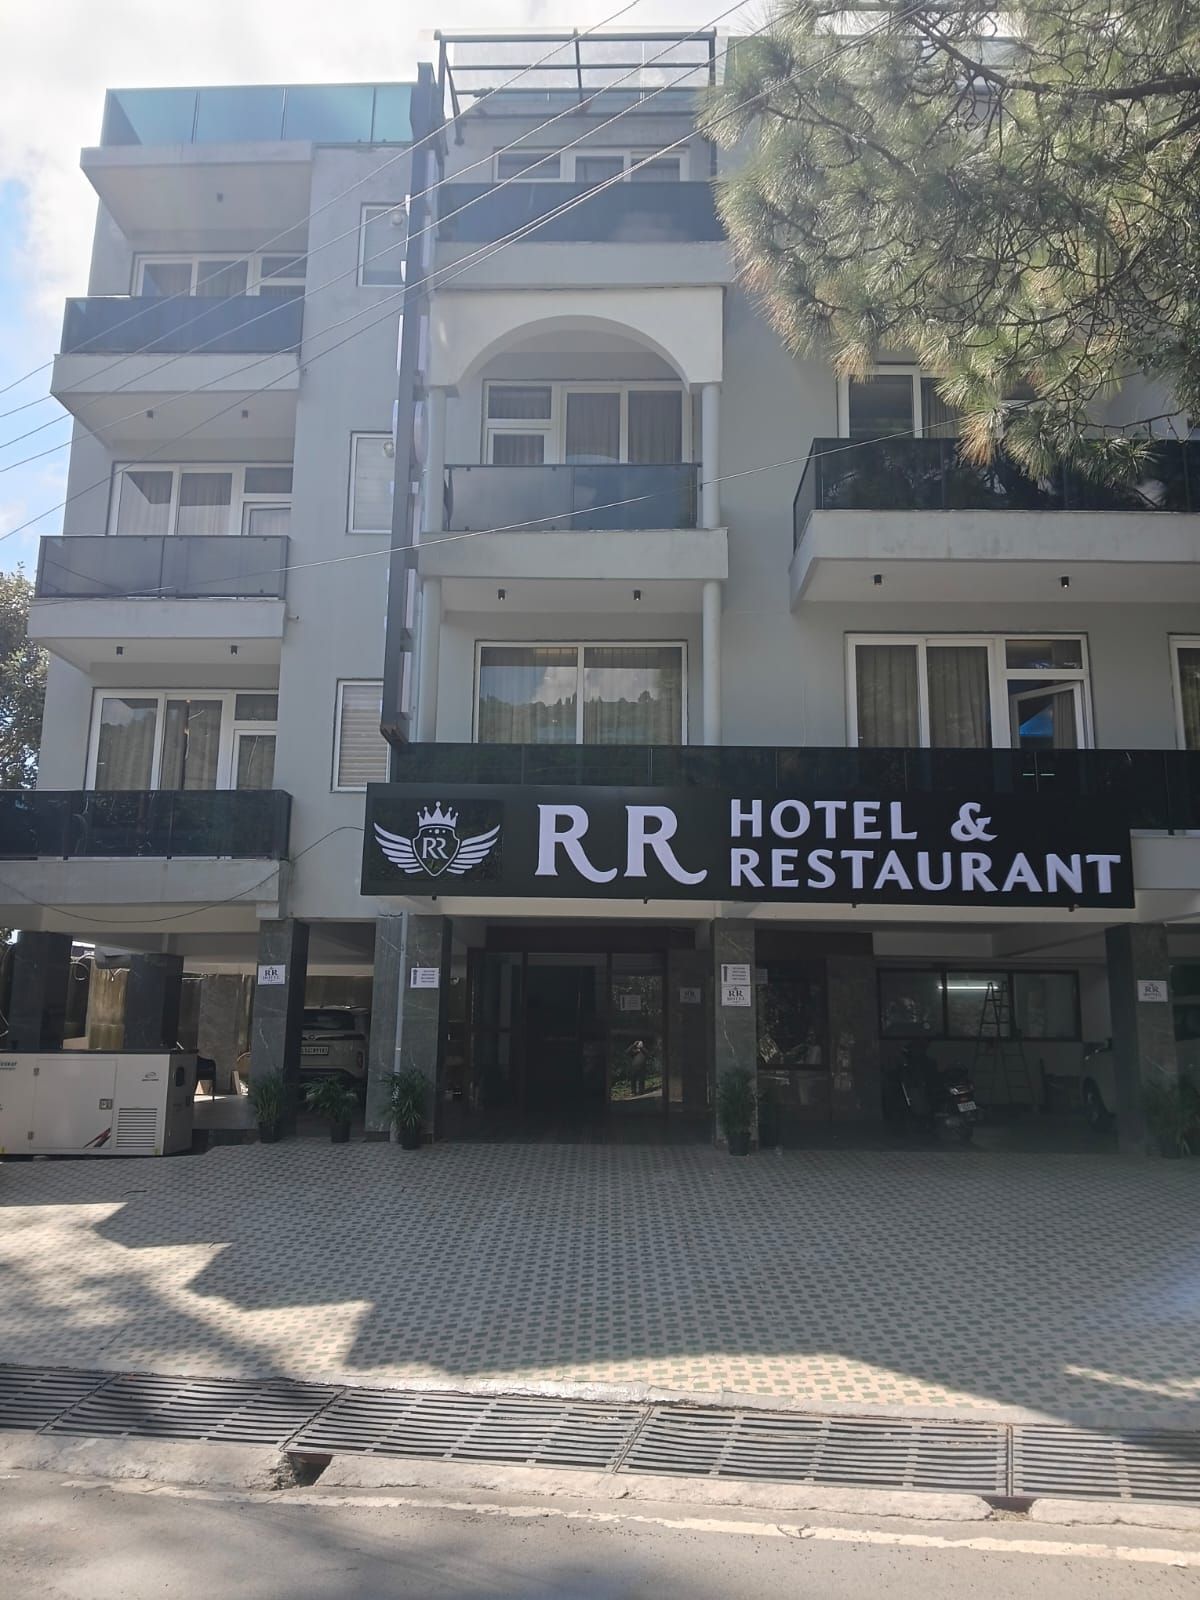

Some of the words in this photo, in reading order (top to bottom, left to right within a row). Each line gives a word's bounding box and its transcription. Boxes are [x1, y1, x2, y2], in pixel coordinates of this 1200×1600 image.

[731, 799, 918, 840] HOTEL
[950, 802, 998, 842] &
[422, 837, 449, 860] RR
[730, 847, 1121, 893] RESTAURANT
